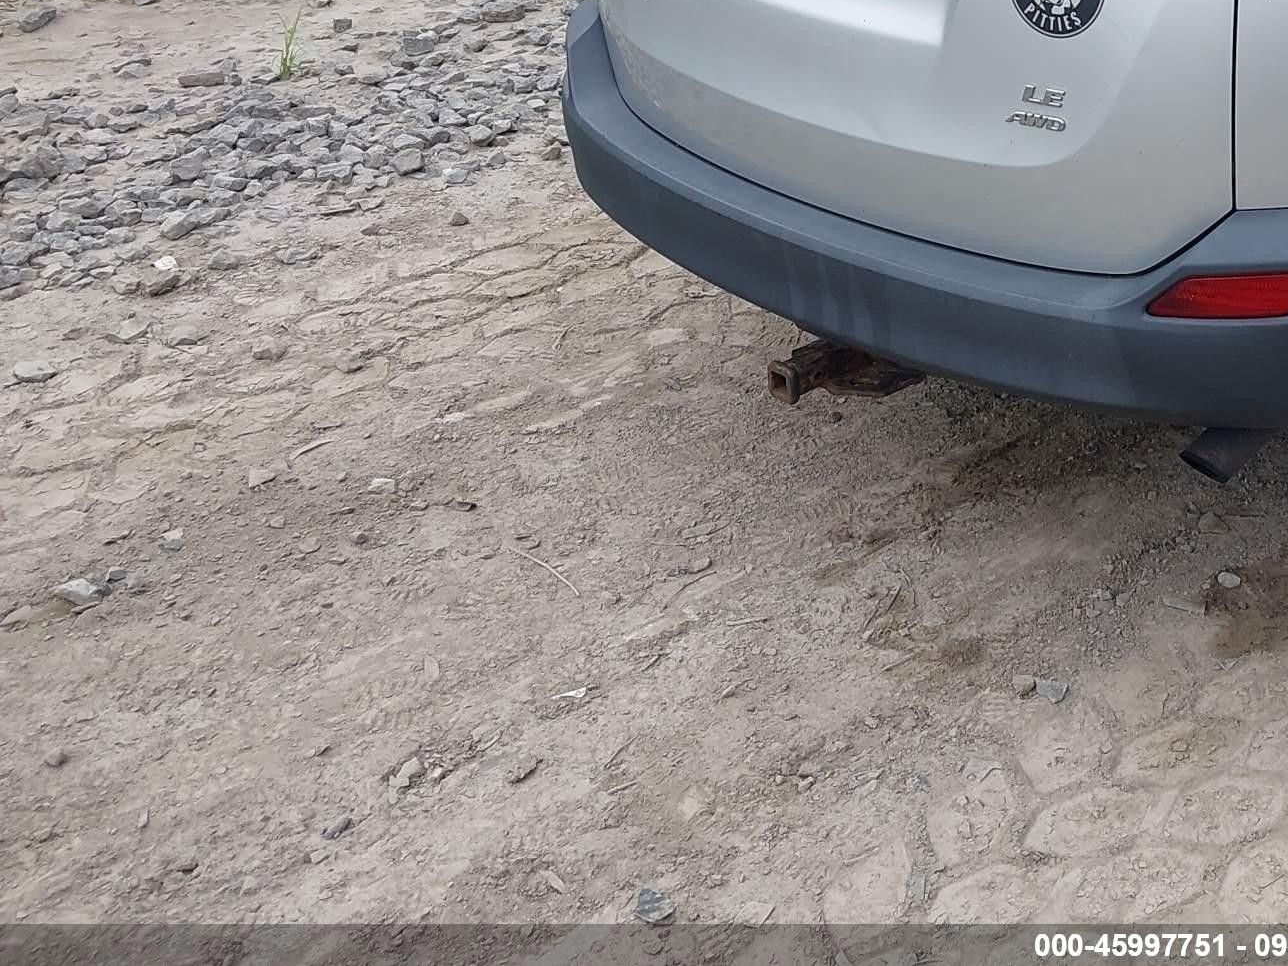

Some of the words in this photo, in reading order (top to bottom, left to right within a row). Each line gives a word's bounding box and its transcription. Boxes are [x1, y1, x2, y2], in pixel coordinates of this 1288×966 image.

[1024, 2, 1082, 32] PITTIES
[1022, 83, 1066, 108] LE
[1005, 110, 1066, 132] AWD
